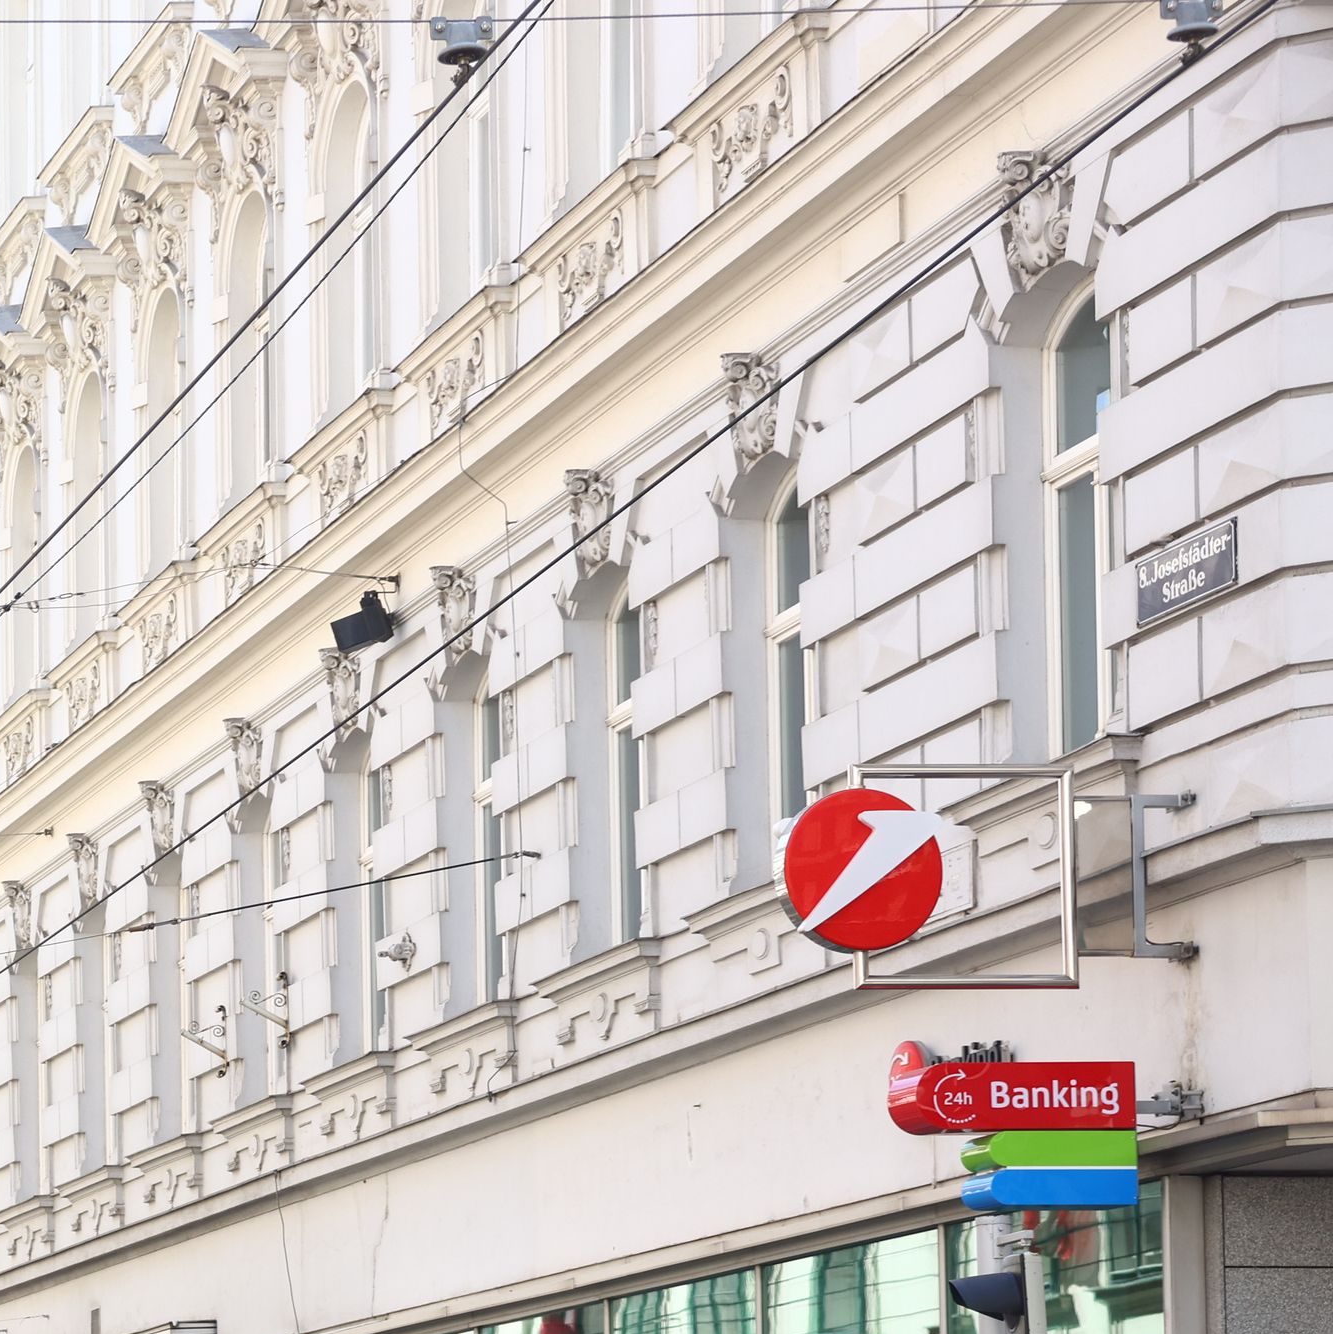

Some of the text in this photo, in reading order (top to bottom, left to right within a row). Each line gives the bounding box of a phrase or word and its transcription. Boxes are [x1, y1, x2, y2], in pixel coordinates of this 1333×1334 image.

[1162, 568, 1206, 604] Straße
[944, 1079, 1121, 1116] 24h Banking
